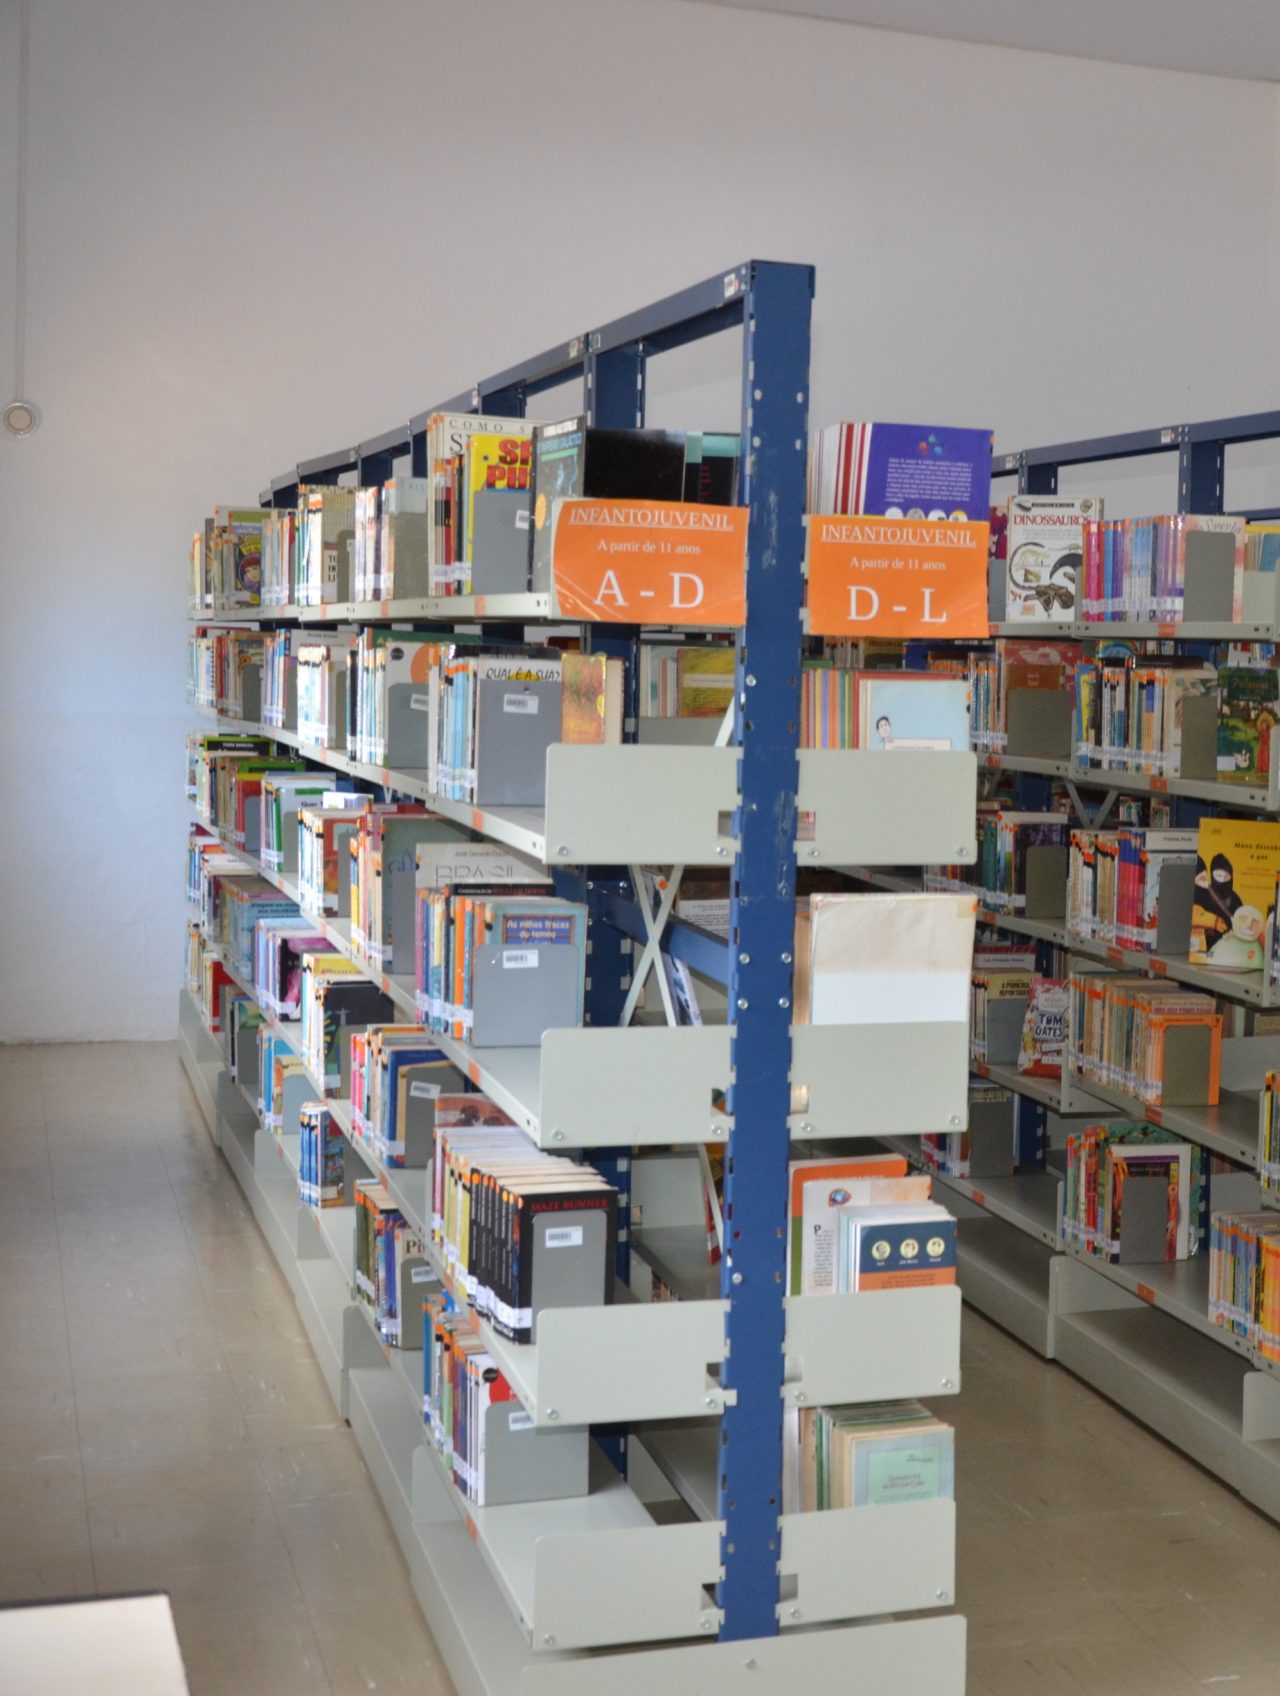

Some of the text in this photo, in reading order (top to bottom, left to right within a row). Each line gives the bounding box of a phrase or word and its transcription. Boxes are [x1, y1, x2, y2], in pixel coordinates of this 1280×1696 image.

[568, 507, 734, 531] INFANTOJUVENIL
[821, 524, 976, 547] INFANTOJUVENIL
[598, 539, 701, 555] A partir de 11 anos
[851, 557, 946, 570] A partir de 11 anos
[594, 570, 628, 606] A
[670, 572, 704, 608] D
[847, 585, 879, 620] D
[920, 588, 947, 622] L
[486, 667, 512, 679] QUAL
[524, 670, 532, 679] A
[535, 669, 560, 681] SUA?
[1039, 1013, 1063, 1025] TOM
[1035, 1026, 1063, 1038] GATES
[530, 1199, 609, 1212] MAZE RUNNER
